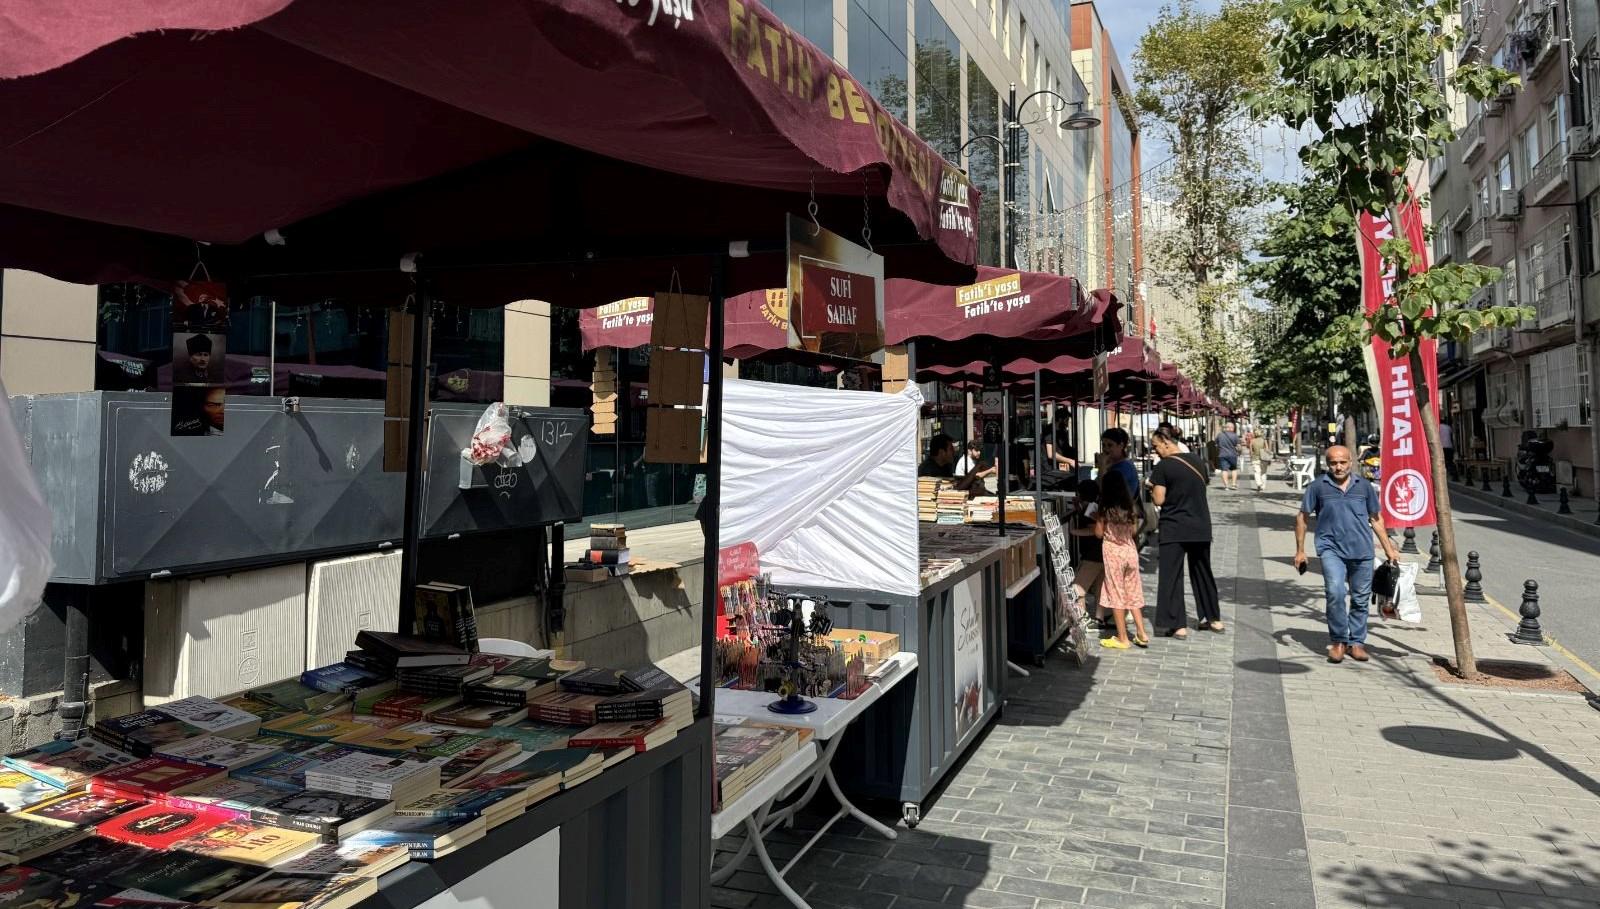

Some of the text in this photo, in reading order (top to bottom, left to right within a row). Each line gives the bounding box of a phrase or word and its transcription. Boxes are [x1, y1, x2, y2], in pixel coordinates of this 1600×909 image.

[830, 274, 852, 299] SUFİ
[958, 279, 1019, 303] Fatih'i yaşa
[759, 303, 781, 328] FATİH
[827, 303, 857, 325] SAHAF
[964, 294, 1031, 319] Fatih'te yaşa
[602, 314, 635, 331] Fatih'te
[541, 420, 574, 446] 1312
